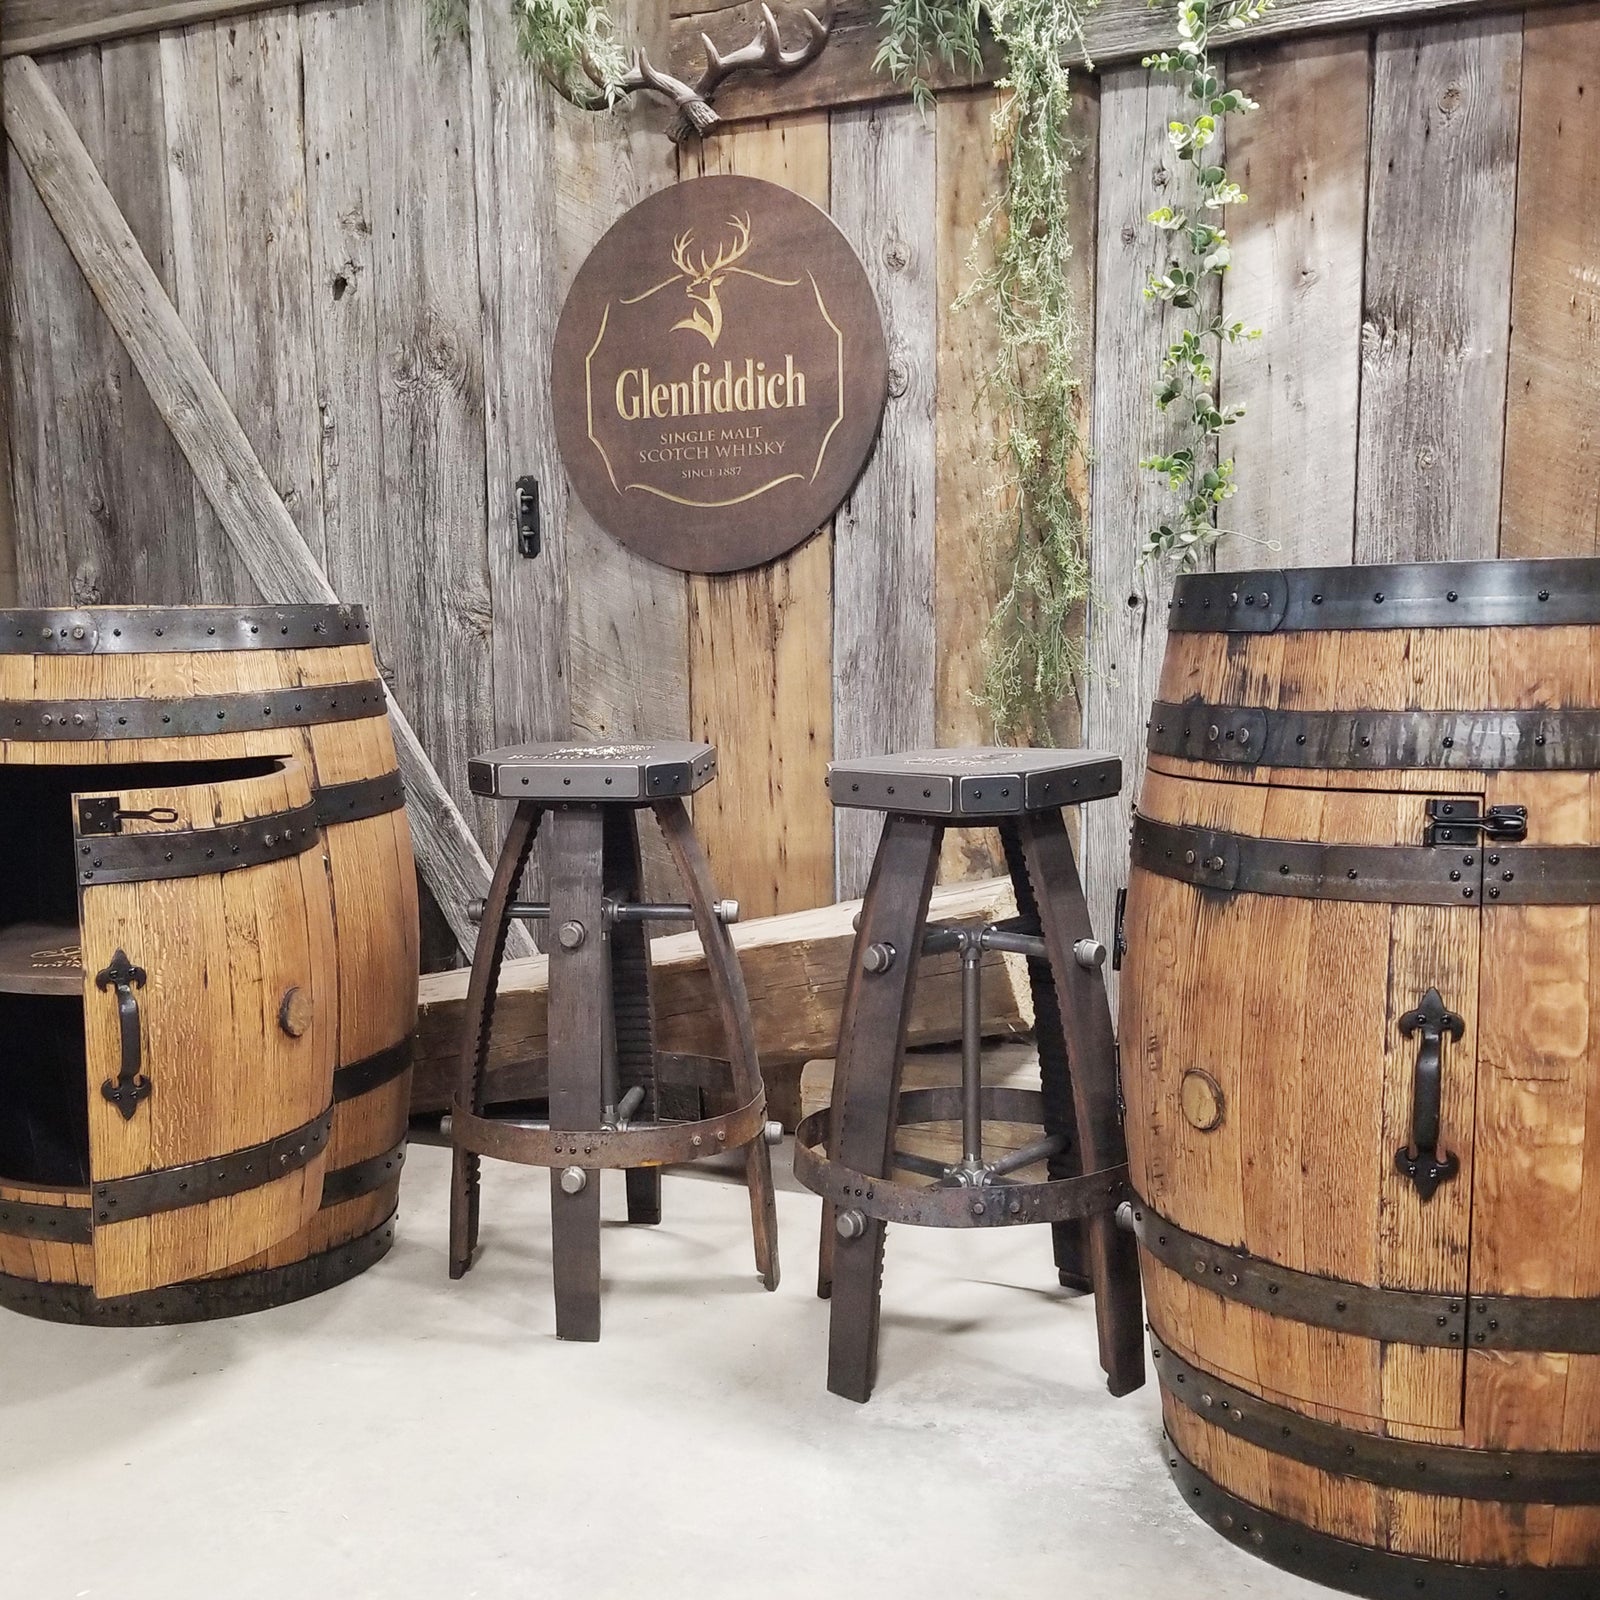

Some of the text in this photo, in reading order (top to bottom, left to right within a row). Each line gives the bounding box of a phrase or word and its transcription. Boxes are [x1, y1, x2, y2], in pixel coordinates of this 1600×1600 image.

[615, 354, 806, 421] Glenfiddich
[660, 426, 763, 445] SINGLE MALT
[639, 441, 786, 463] SCOTCH WHISKY
[681, 466, 742, 479] SINCE 1887
